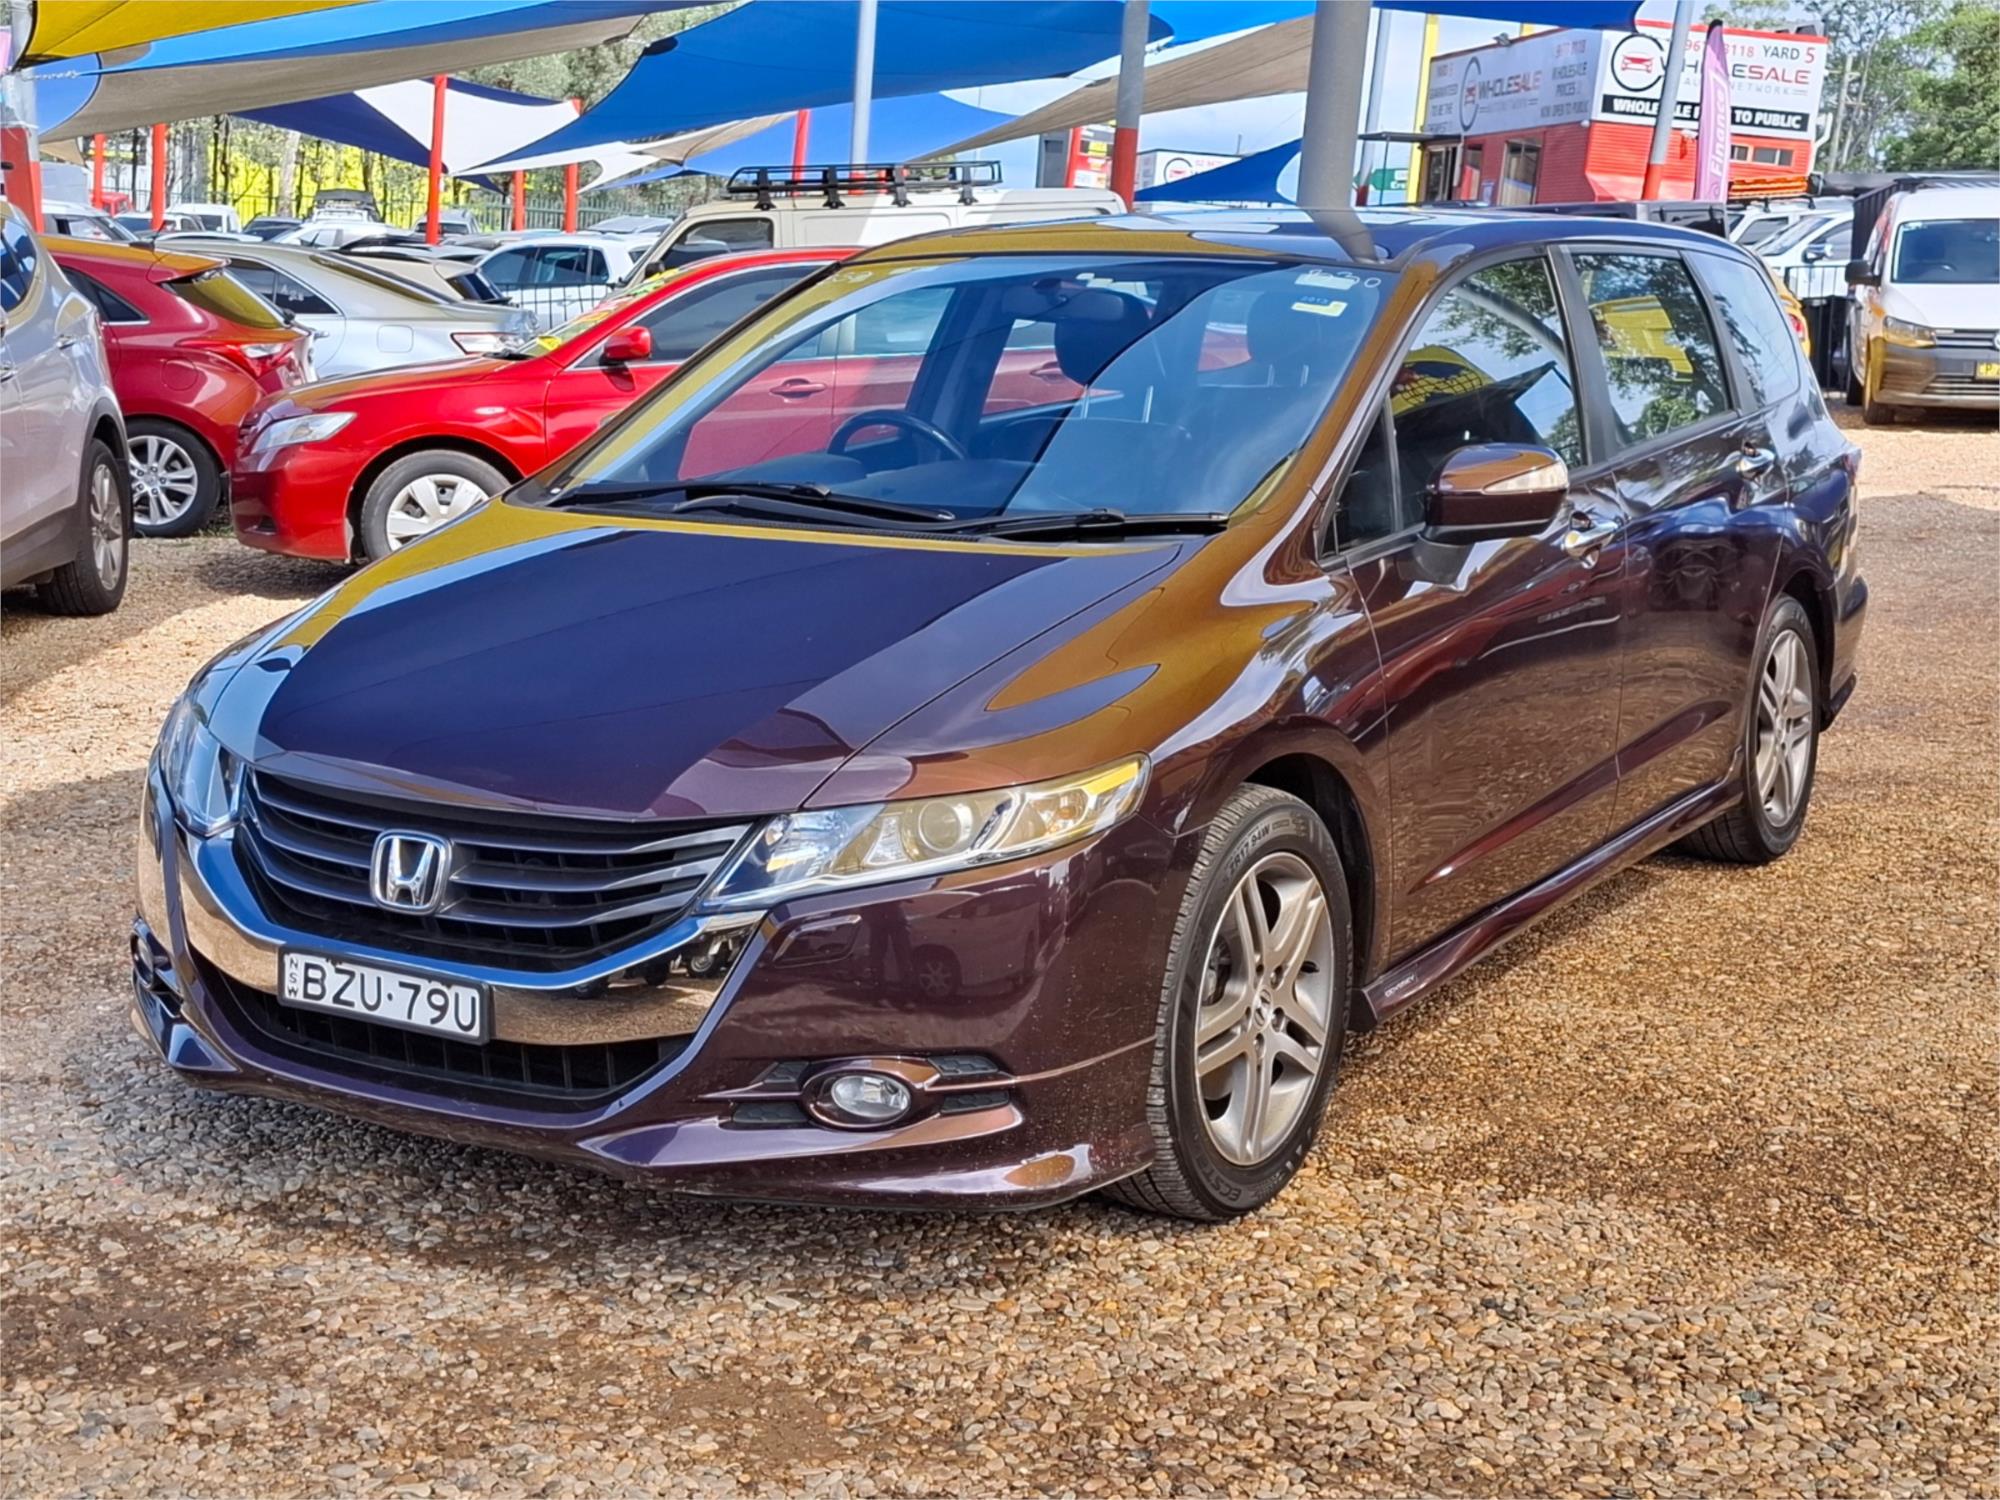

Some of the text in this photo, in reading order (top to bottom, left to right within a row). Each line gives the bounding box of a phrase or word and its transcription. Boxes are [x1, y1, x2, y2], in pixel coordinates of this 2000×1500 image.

[1763, 45, 1801, 61] YARD
[1805, 47, 1816, 64] 5
[1478, 70, 1542, 100] WHOLESALE
[1660, 56, 1812, 85] HESALE
[1613, 98, 1692, 119] WHOLELE
[1734, 109, 1753, 124] TO
[1754, 111, 1802, 130] PUBLIC
